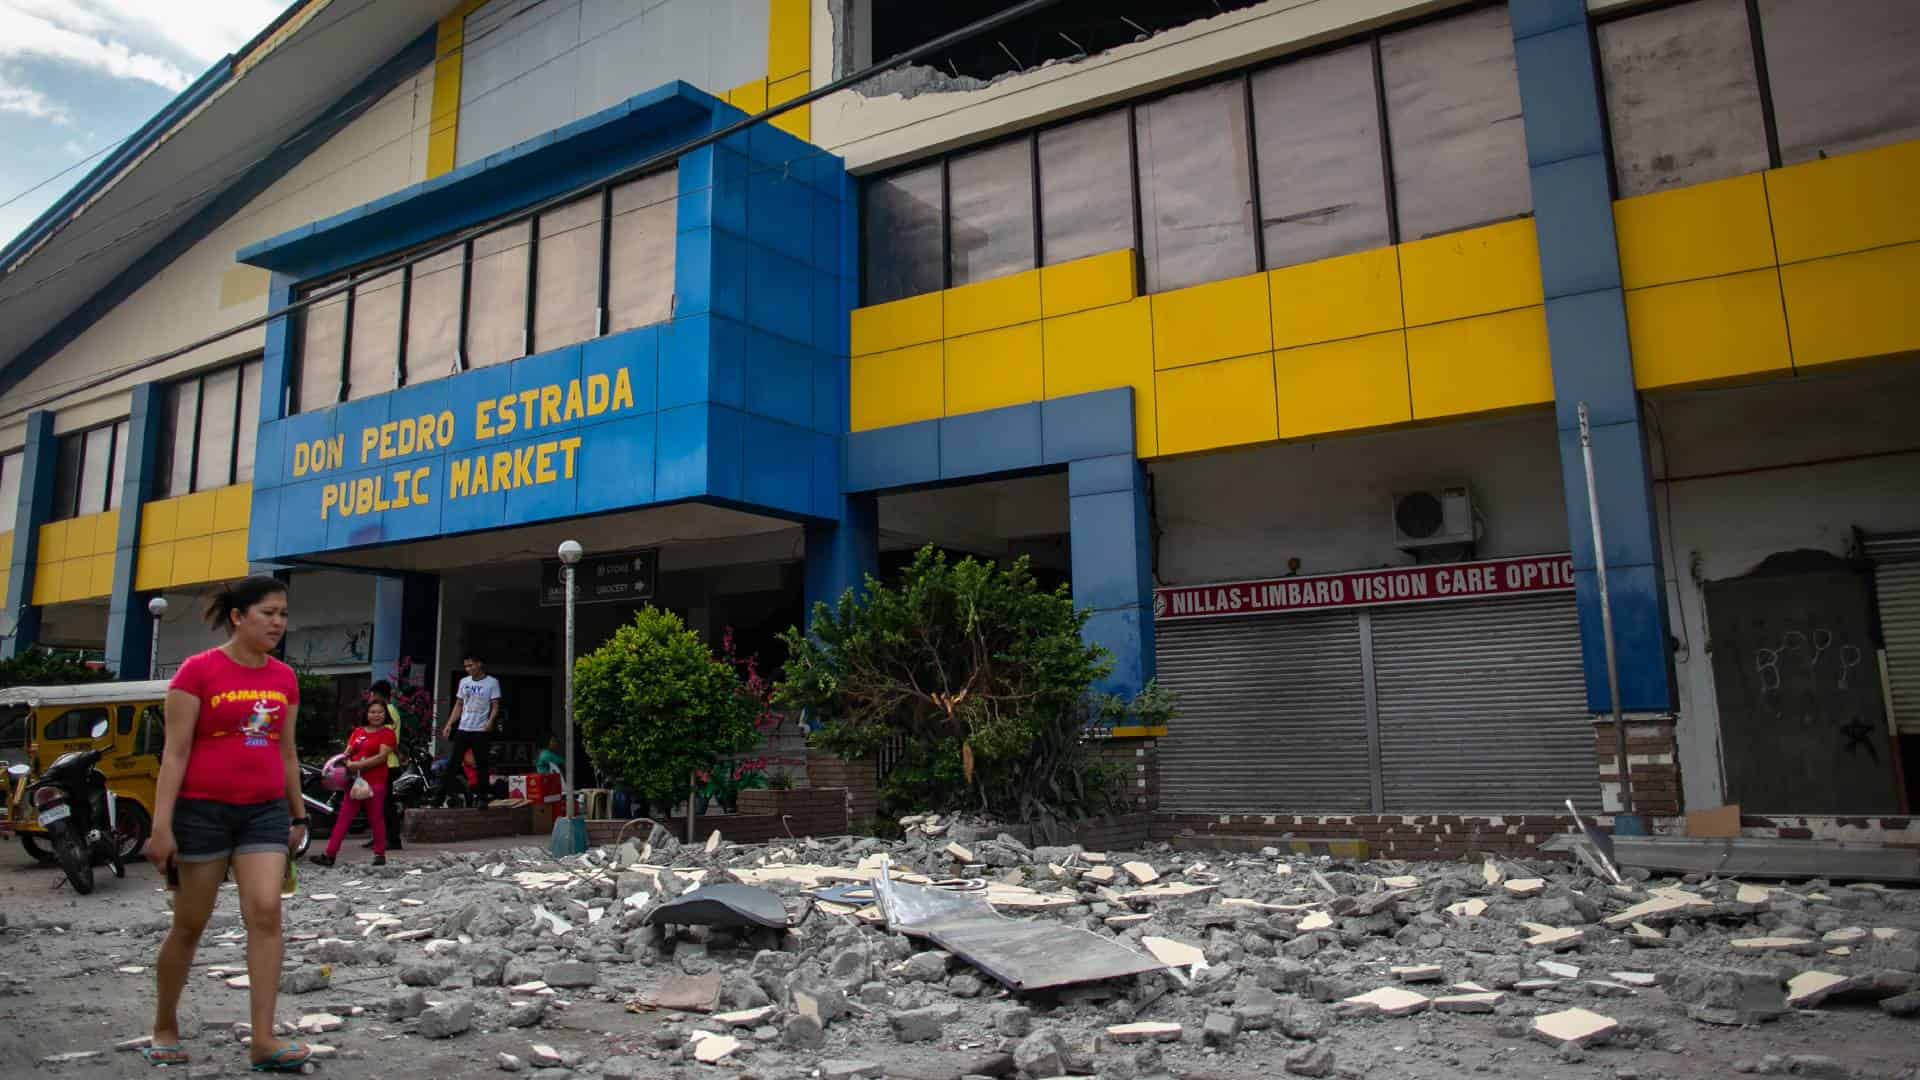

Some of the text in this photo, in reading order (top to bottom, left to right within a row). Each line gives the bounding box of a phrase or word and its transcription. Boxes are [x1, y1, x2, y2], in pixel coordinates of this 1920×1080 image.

[293, 367, 634, 477] DON PEDRO ESTRADA
[320, 437, 582, 520] PUBLIC MARKET
[1172, 558, 1577, 614] NILLAS-LIMBARO VISION CARE OPTIC
